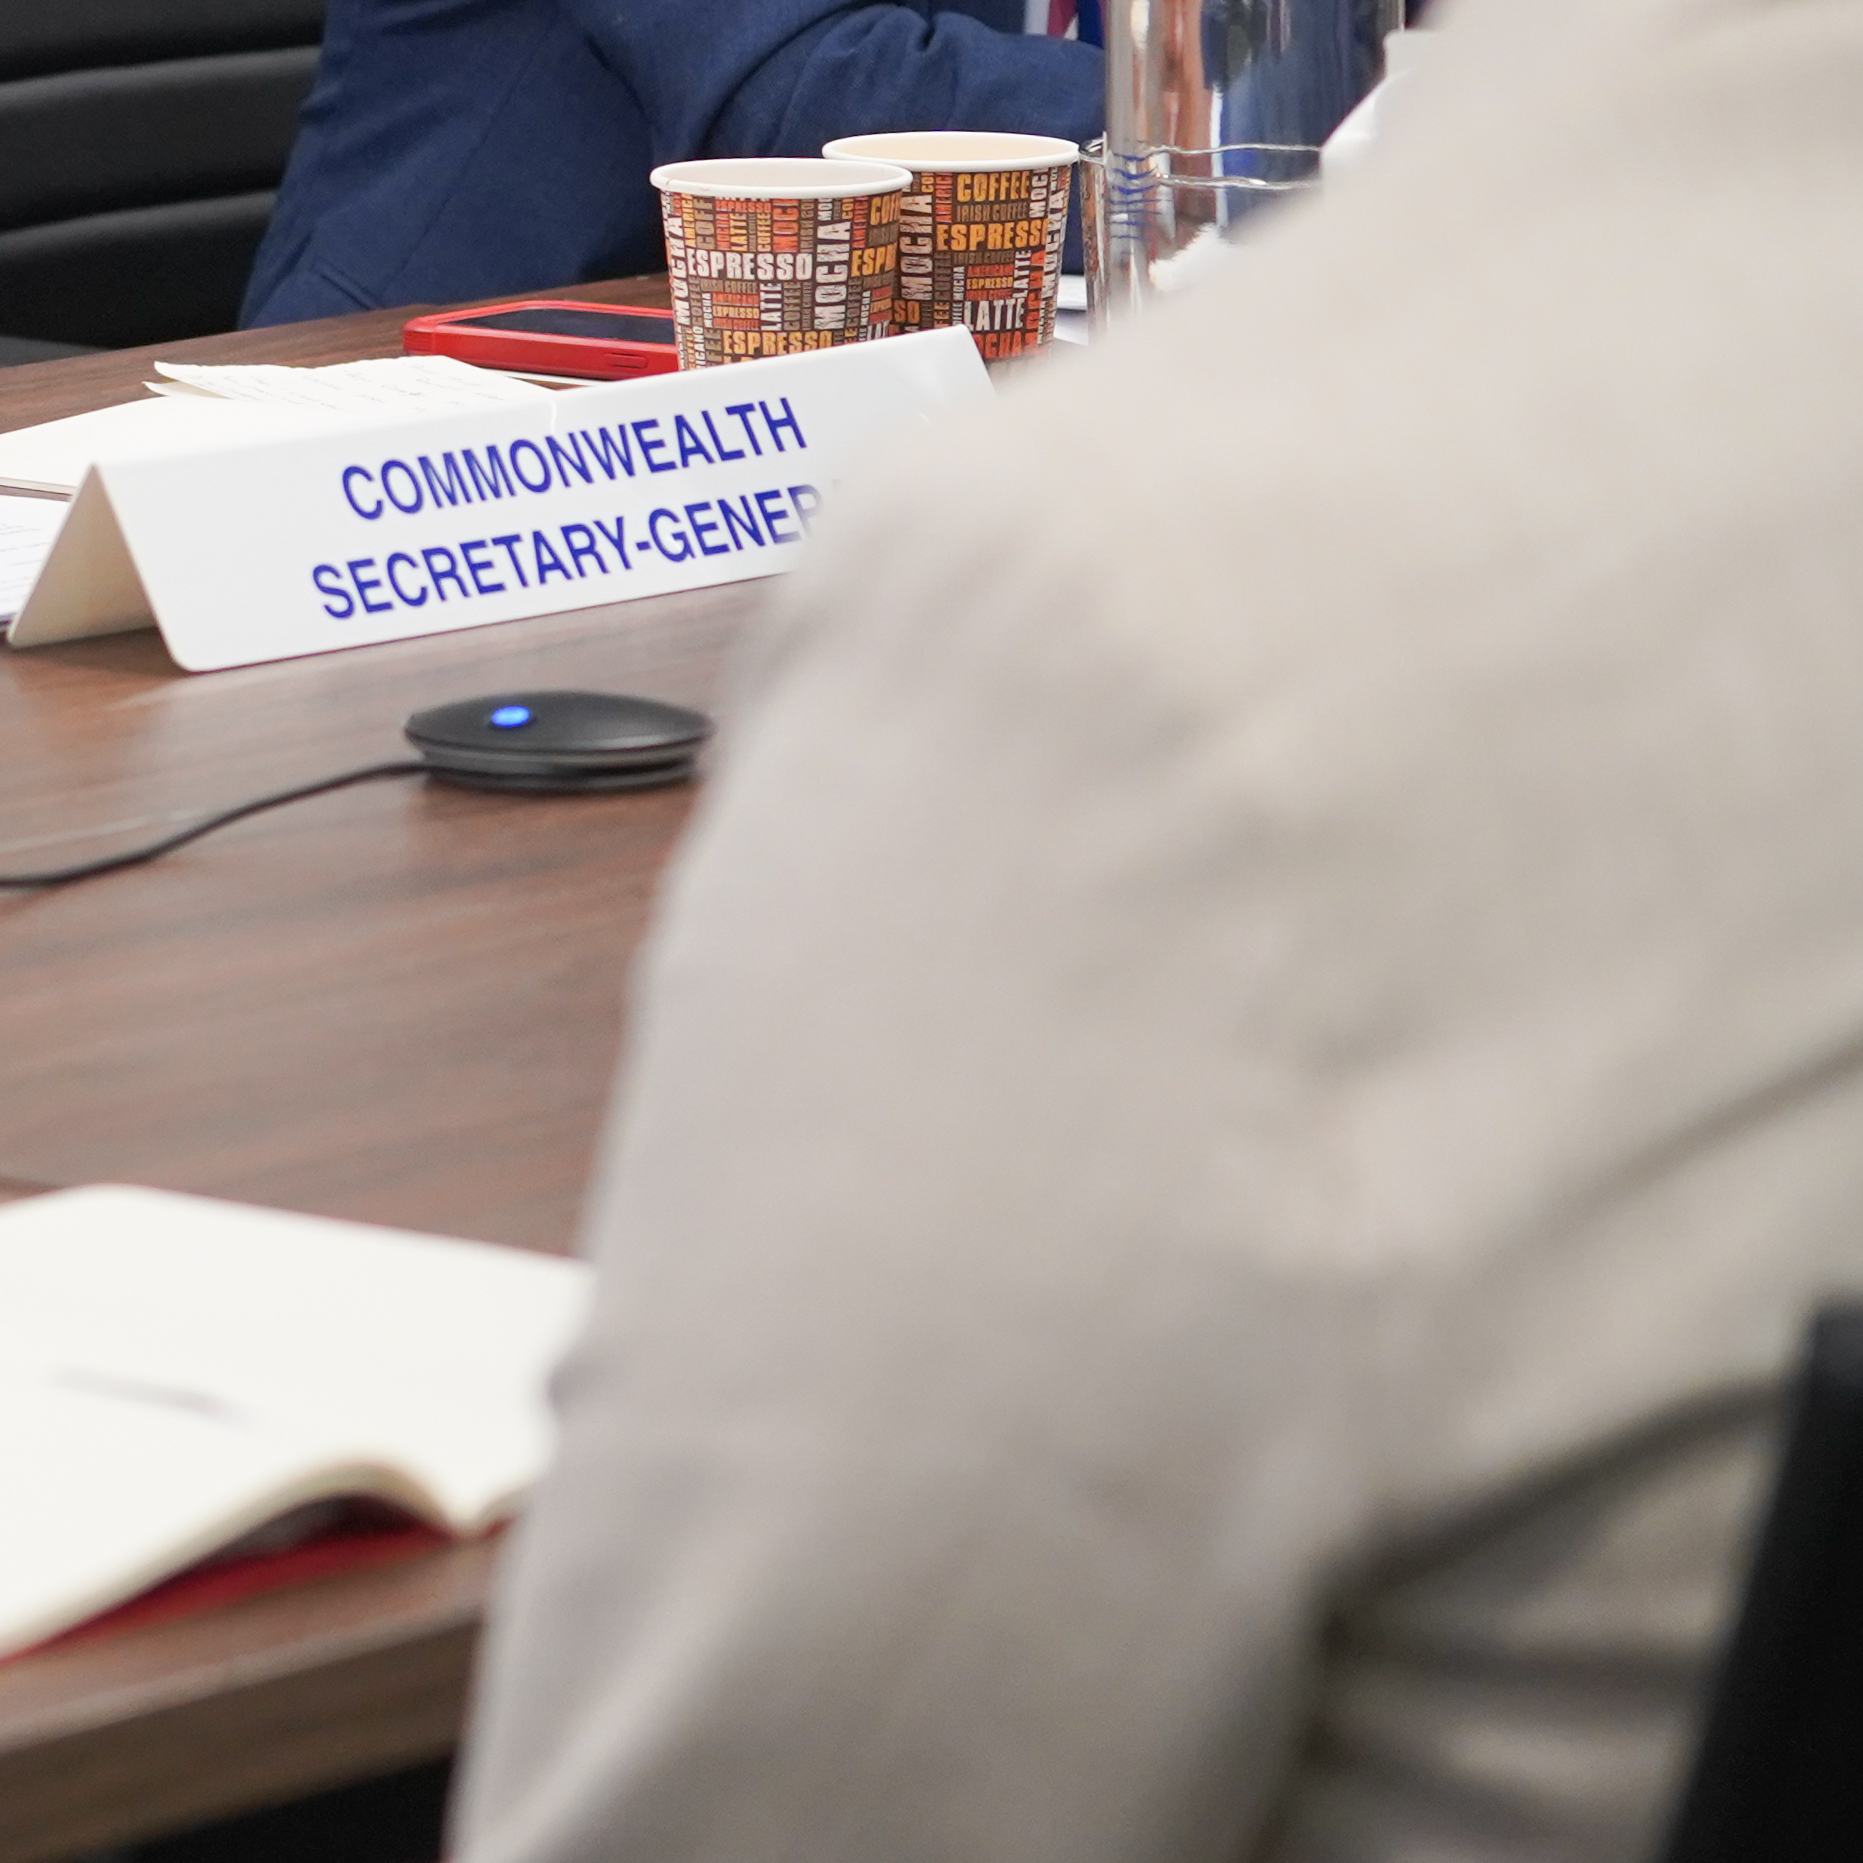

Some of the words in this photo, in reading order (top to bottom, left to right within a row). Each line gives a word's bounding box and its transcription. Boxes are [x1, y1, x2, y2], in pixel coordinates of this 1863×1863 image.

[921, 172, 935, 193] CO
[935, 172, 952, 224] AMERIC
[956, 171, 1030, 202] COFFEE
[1029, 168, 1049, 218] MOC
[694, 198, 714, 249] COFF
[716, 199, 772, 212] ESPRESSO
[956, 204, 990, 223] IRISH
[992, 202, 1028, 221] COFFEE
[716, 213, 730, 250] MOCHA
[730, 213, 748, 251] LATTE
[757, 212, 772, 252] COFFEE
[900, 195, 933, 300] MOCHA
[667, 217, 691, 325] MOCHA
[686, 248, 813, 281] ESPRESSO
[814, 221, 851, 330] MOCHA
[966, 276, 1014, 290] ESPRESSO
[1012, 250, 1032, 298] LATTE
[953, 266, 965, 301] MOCHA
[702, 293, 712, 328] MOCHA
[712, 306, 760, 319] ESPRESSO
[759, 282, 782, 331] LATTE
[783, 282, 801, 331] COFFEE
[860, 290, 871, 325] MOCHA
[964, 298, 1025, 331] LATTE
[704, 329, 722, 363] FEE
[722, 330, 833, 356] ESPRESSO
[341, 397, 808, 521] COMMONWEALTH
[312, 483, 823, 620] SECRETARY-GENER
